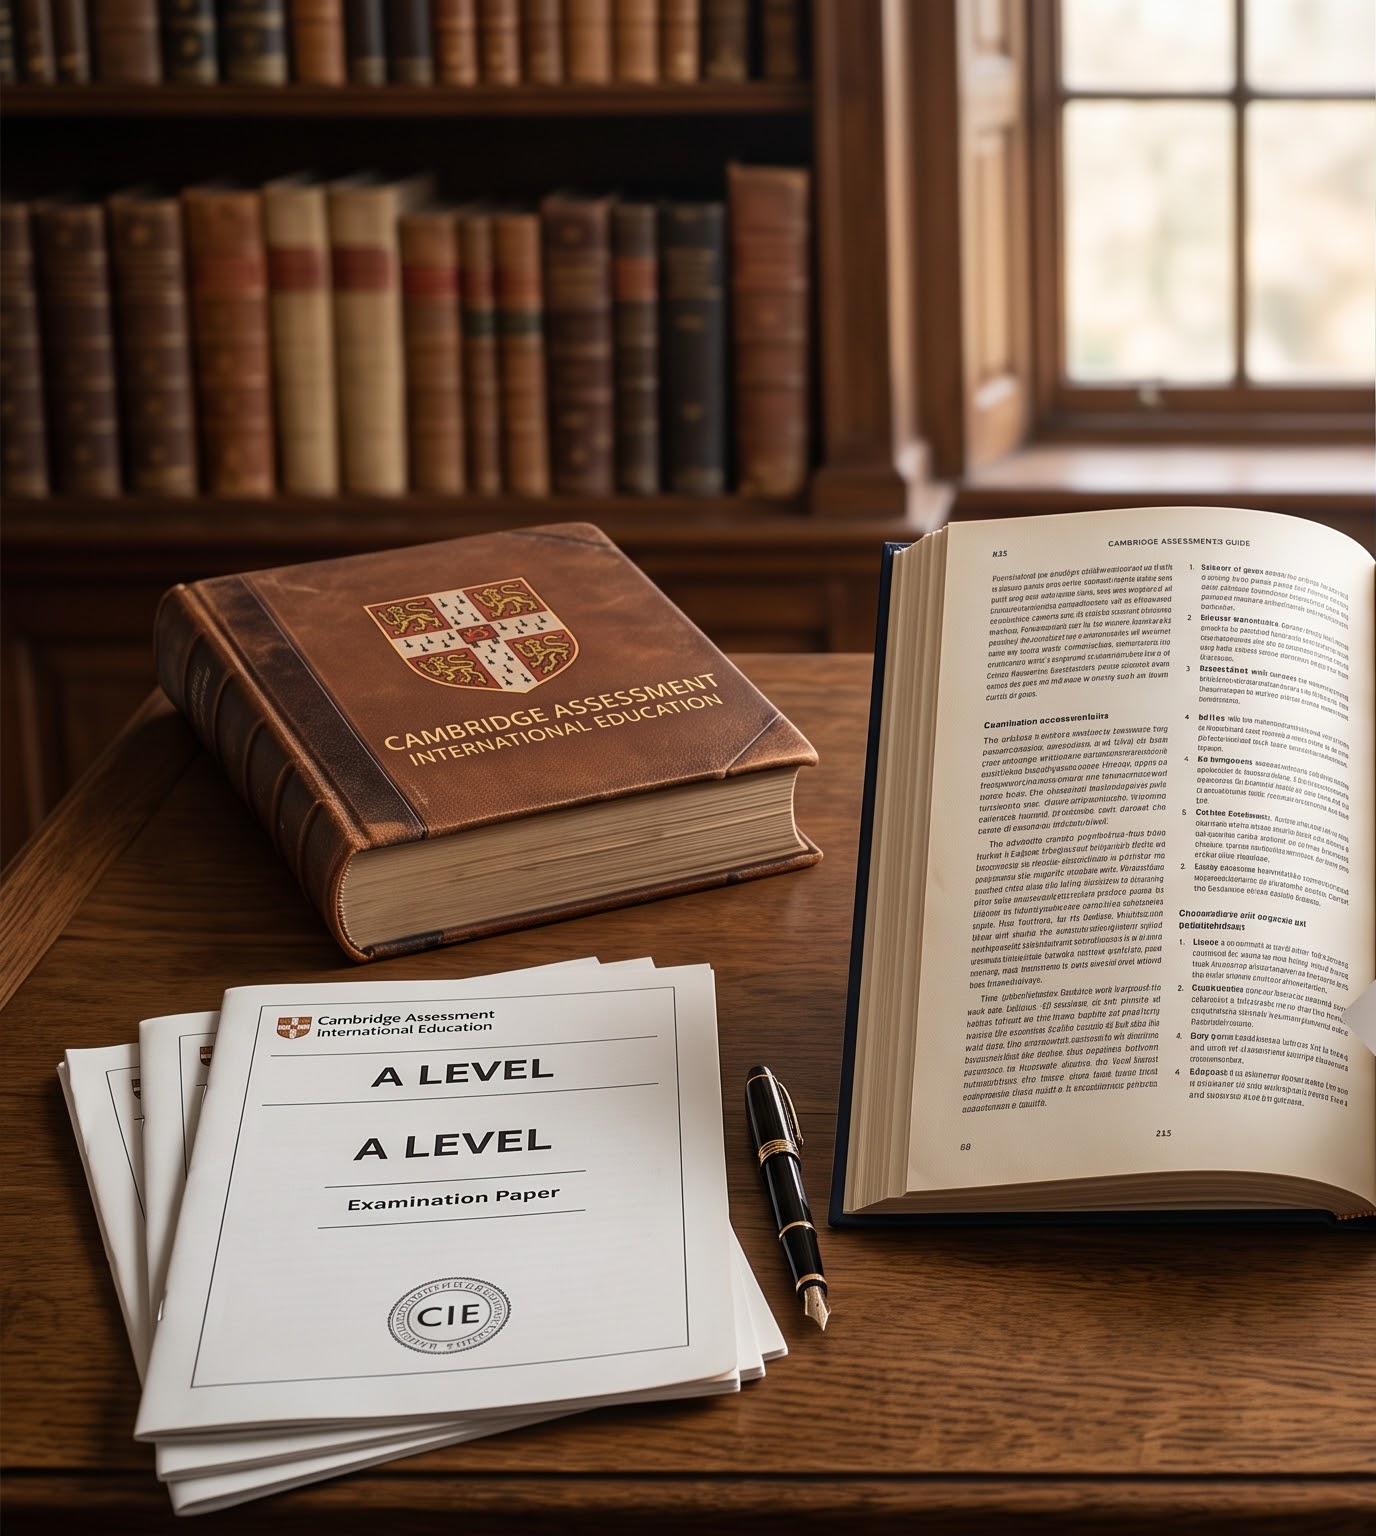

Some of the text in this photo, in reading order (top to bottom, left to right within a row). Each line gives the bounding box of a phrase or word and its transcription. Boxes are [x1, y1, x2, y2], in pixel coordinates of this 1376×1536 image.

[384, 673, 719, 751] CAMBRIDGE ASSESSMENT
[409, 693, 724, 766] INTERNATIONAL EDUCATION
[317, 1022, 492, 1038] International Education
[318, 1010, 495, 1027] Cambridge Assessment
[371, 1058, 554, 1088] A LEVEL
[353, 1128, 552, 1161] A LEVEL
[348, 1188, 560, 1212] Examination Paper
[417, 1304, 480, 1327] CIE
